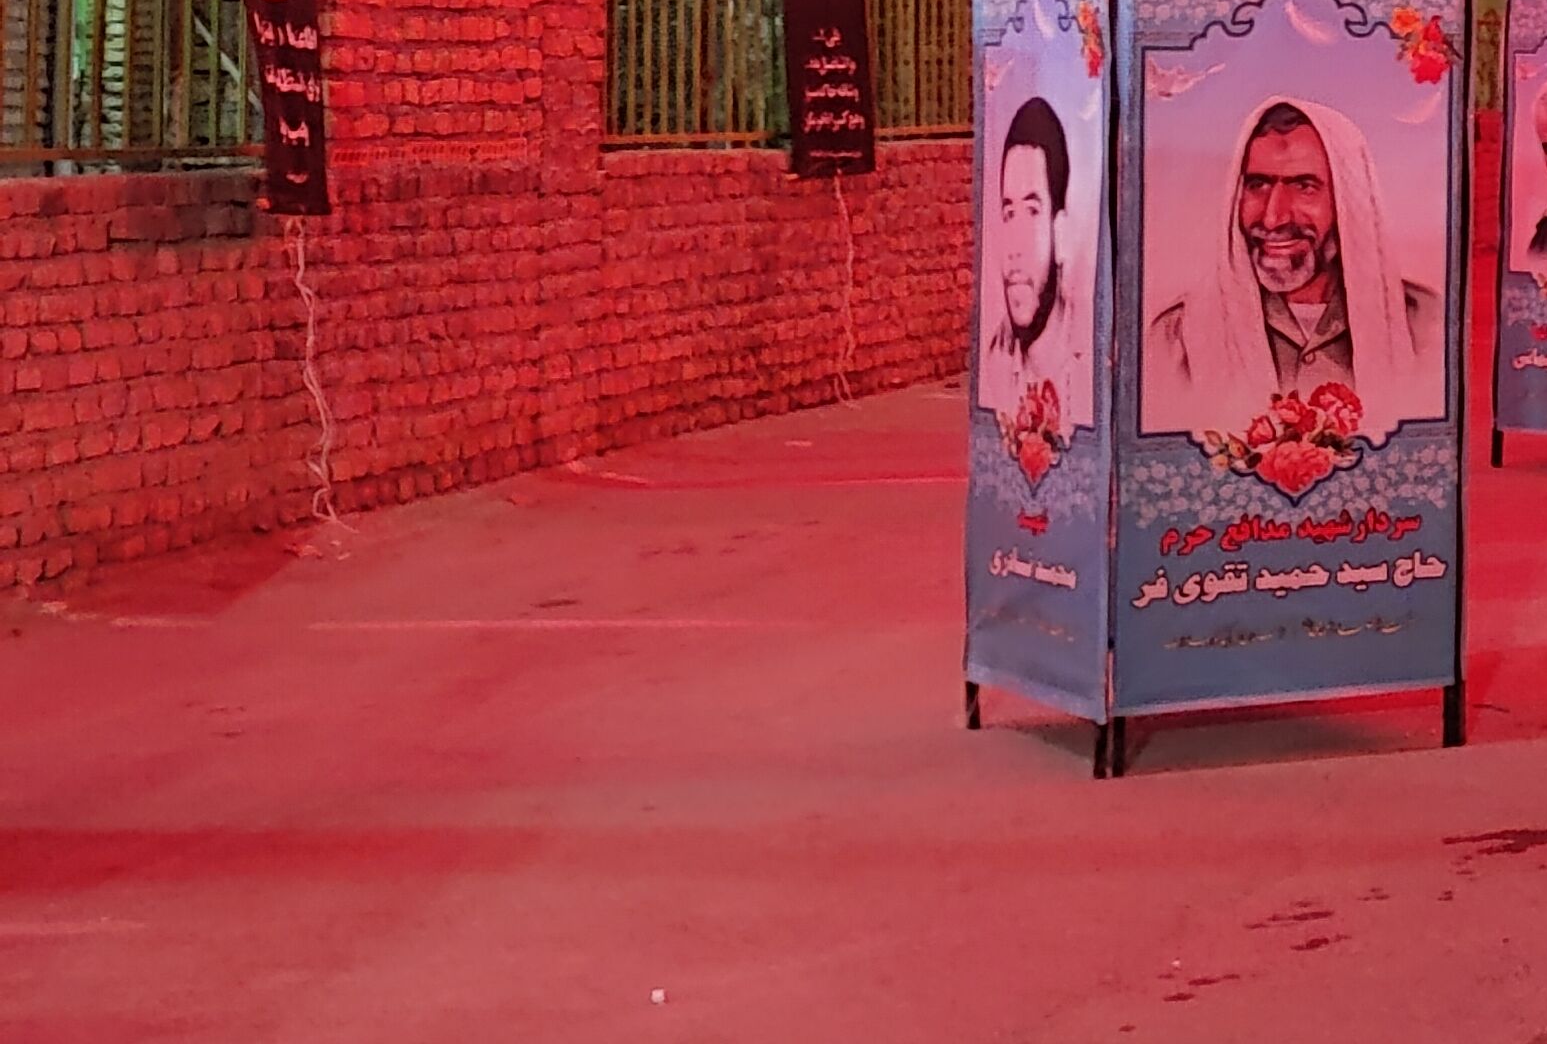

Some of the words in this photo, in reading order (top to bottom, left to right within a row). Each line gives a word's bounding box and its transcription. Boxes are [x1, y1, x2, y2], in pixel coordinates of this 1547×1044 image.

[1159, 524, 1216, 556] حرم
[1220, 513, 1292, 552] مدافع
[1297, 509, 1352, 544] شهید
[1351, 507, 1422, 543] سردار
[1130, 565, 1170, 608] فر
[1172, 560, 1249, 606] تقوی
[1254, 563, 1331, 598] حمید
[1336, 560, 1389, 592] سید
[1392, 550, 1448, 588] حاج
